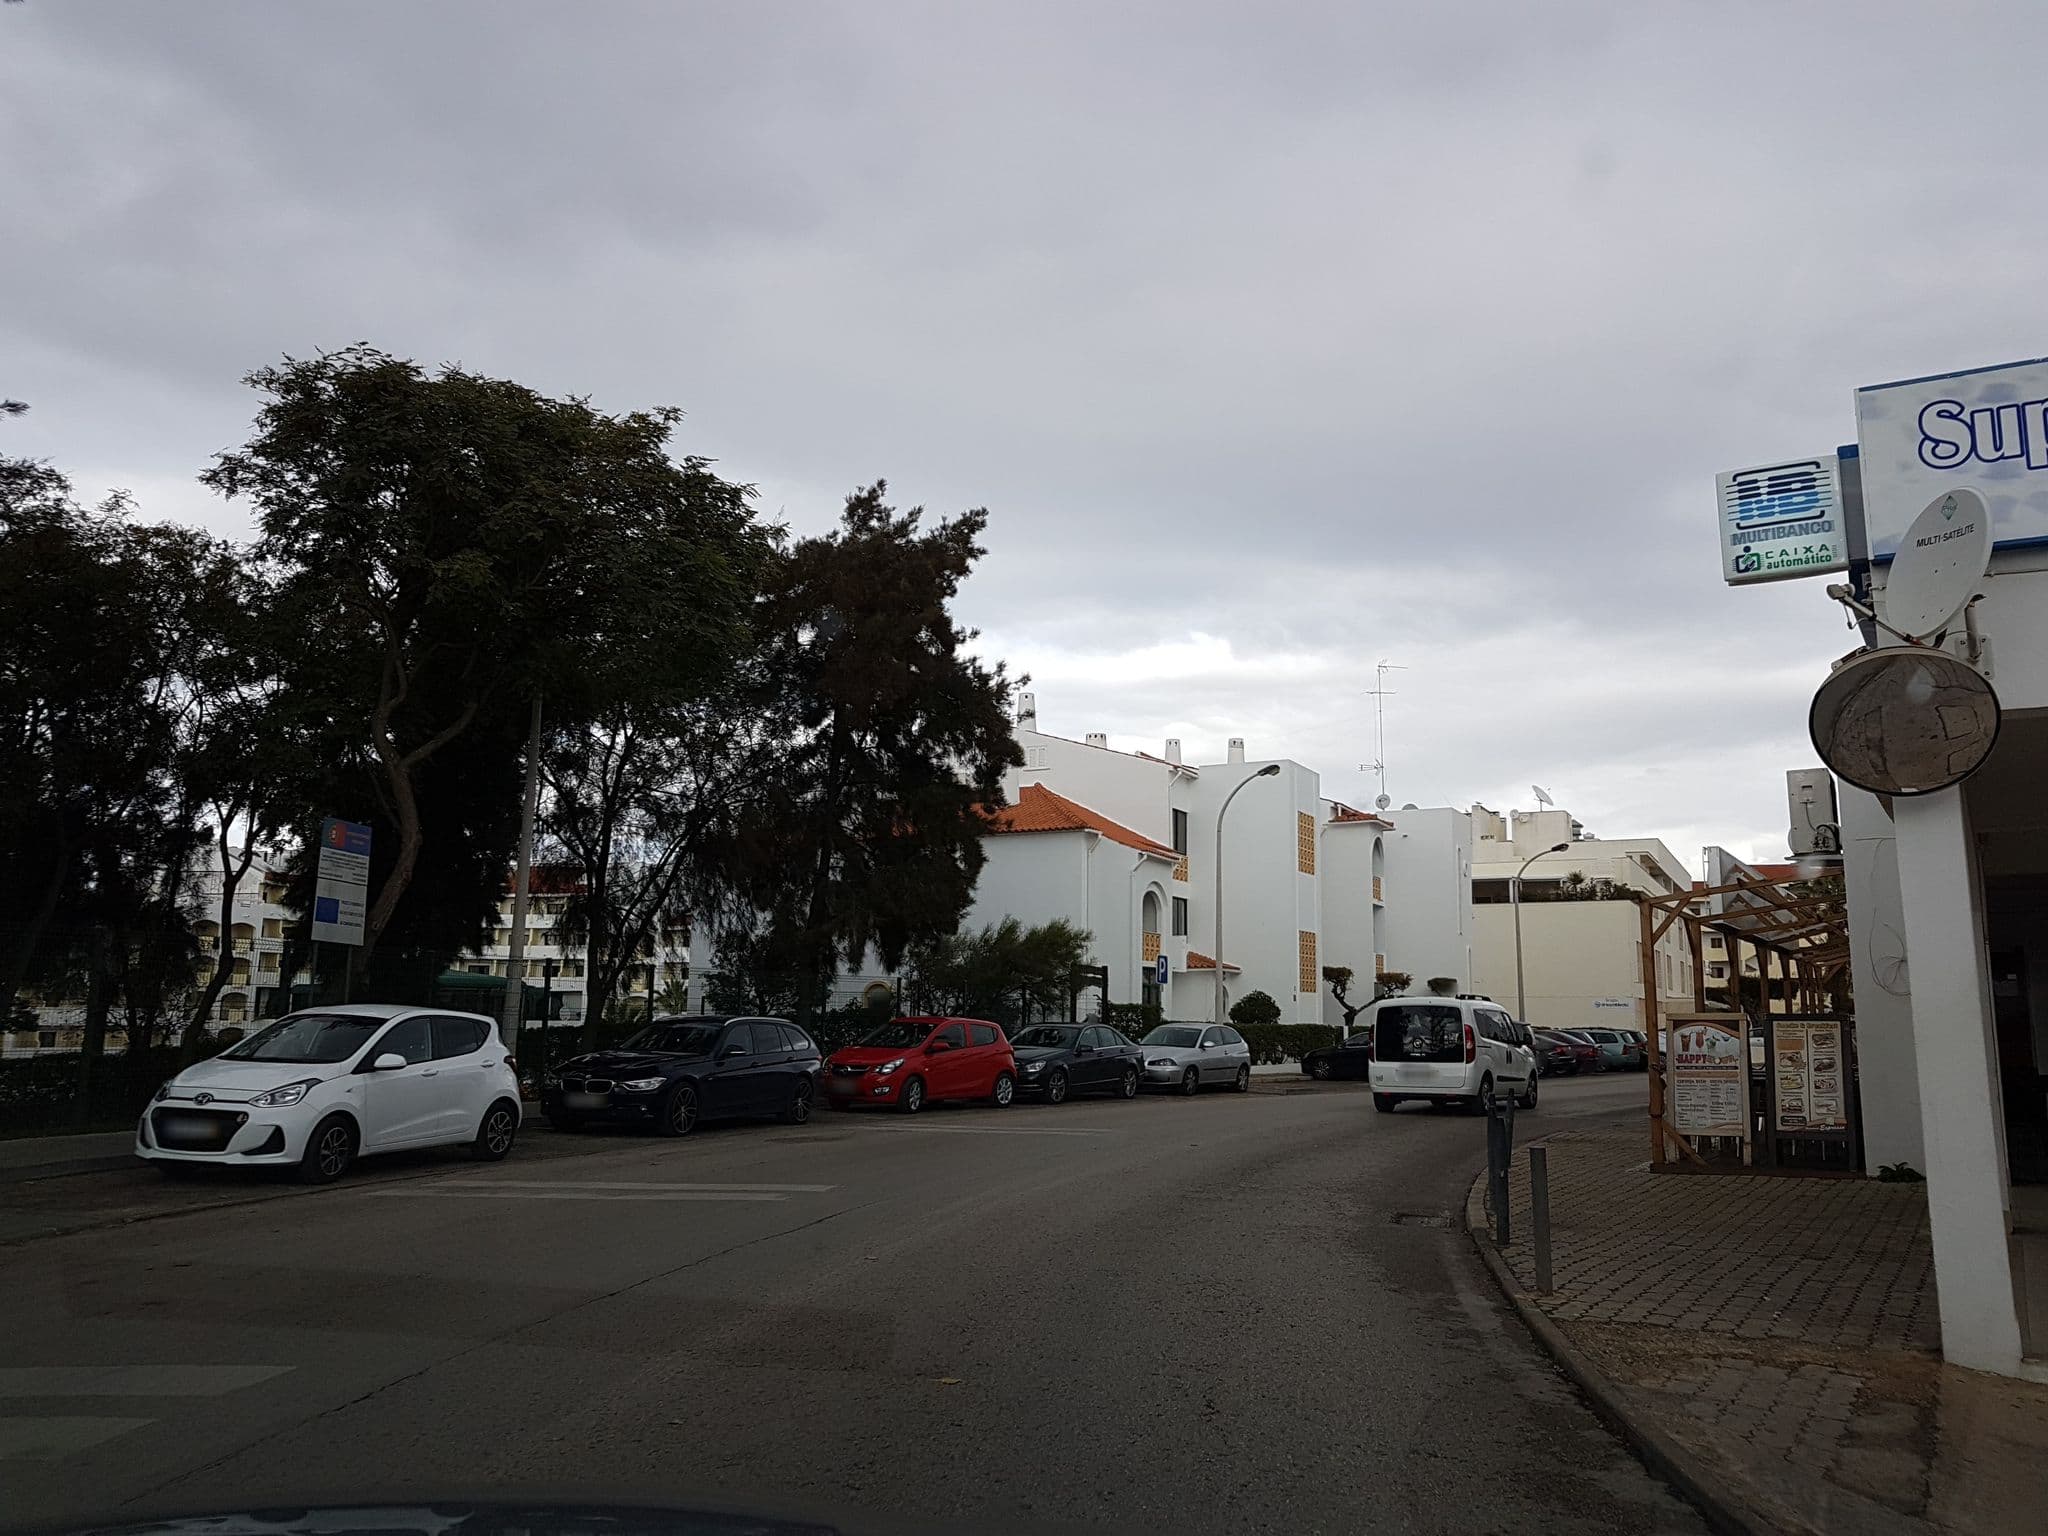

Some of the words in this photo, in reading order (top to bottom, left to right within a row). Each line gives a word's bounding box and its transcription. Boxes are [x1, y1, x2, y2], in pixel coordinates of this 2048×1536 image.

[1731, 520, 1832, 545] MULTIBANCO
[1765, 544, 1830, 559] CAIXA
[1767, 553, 1832, 570] automático
[1159, 957, 1166, 981] P
